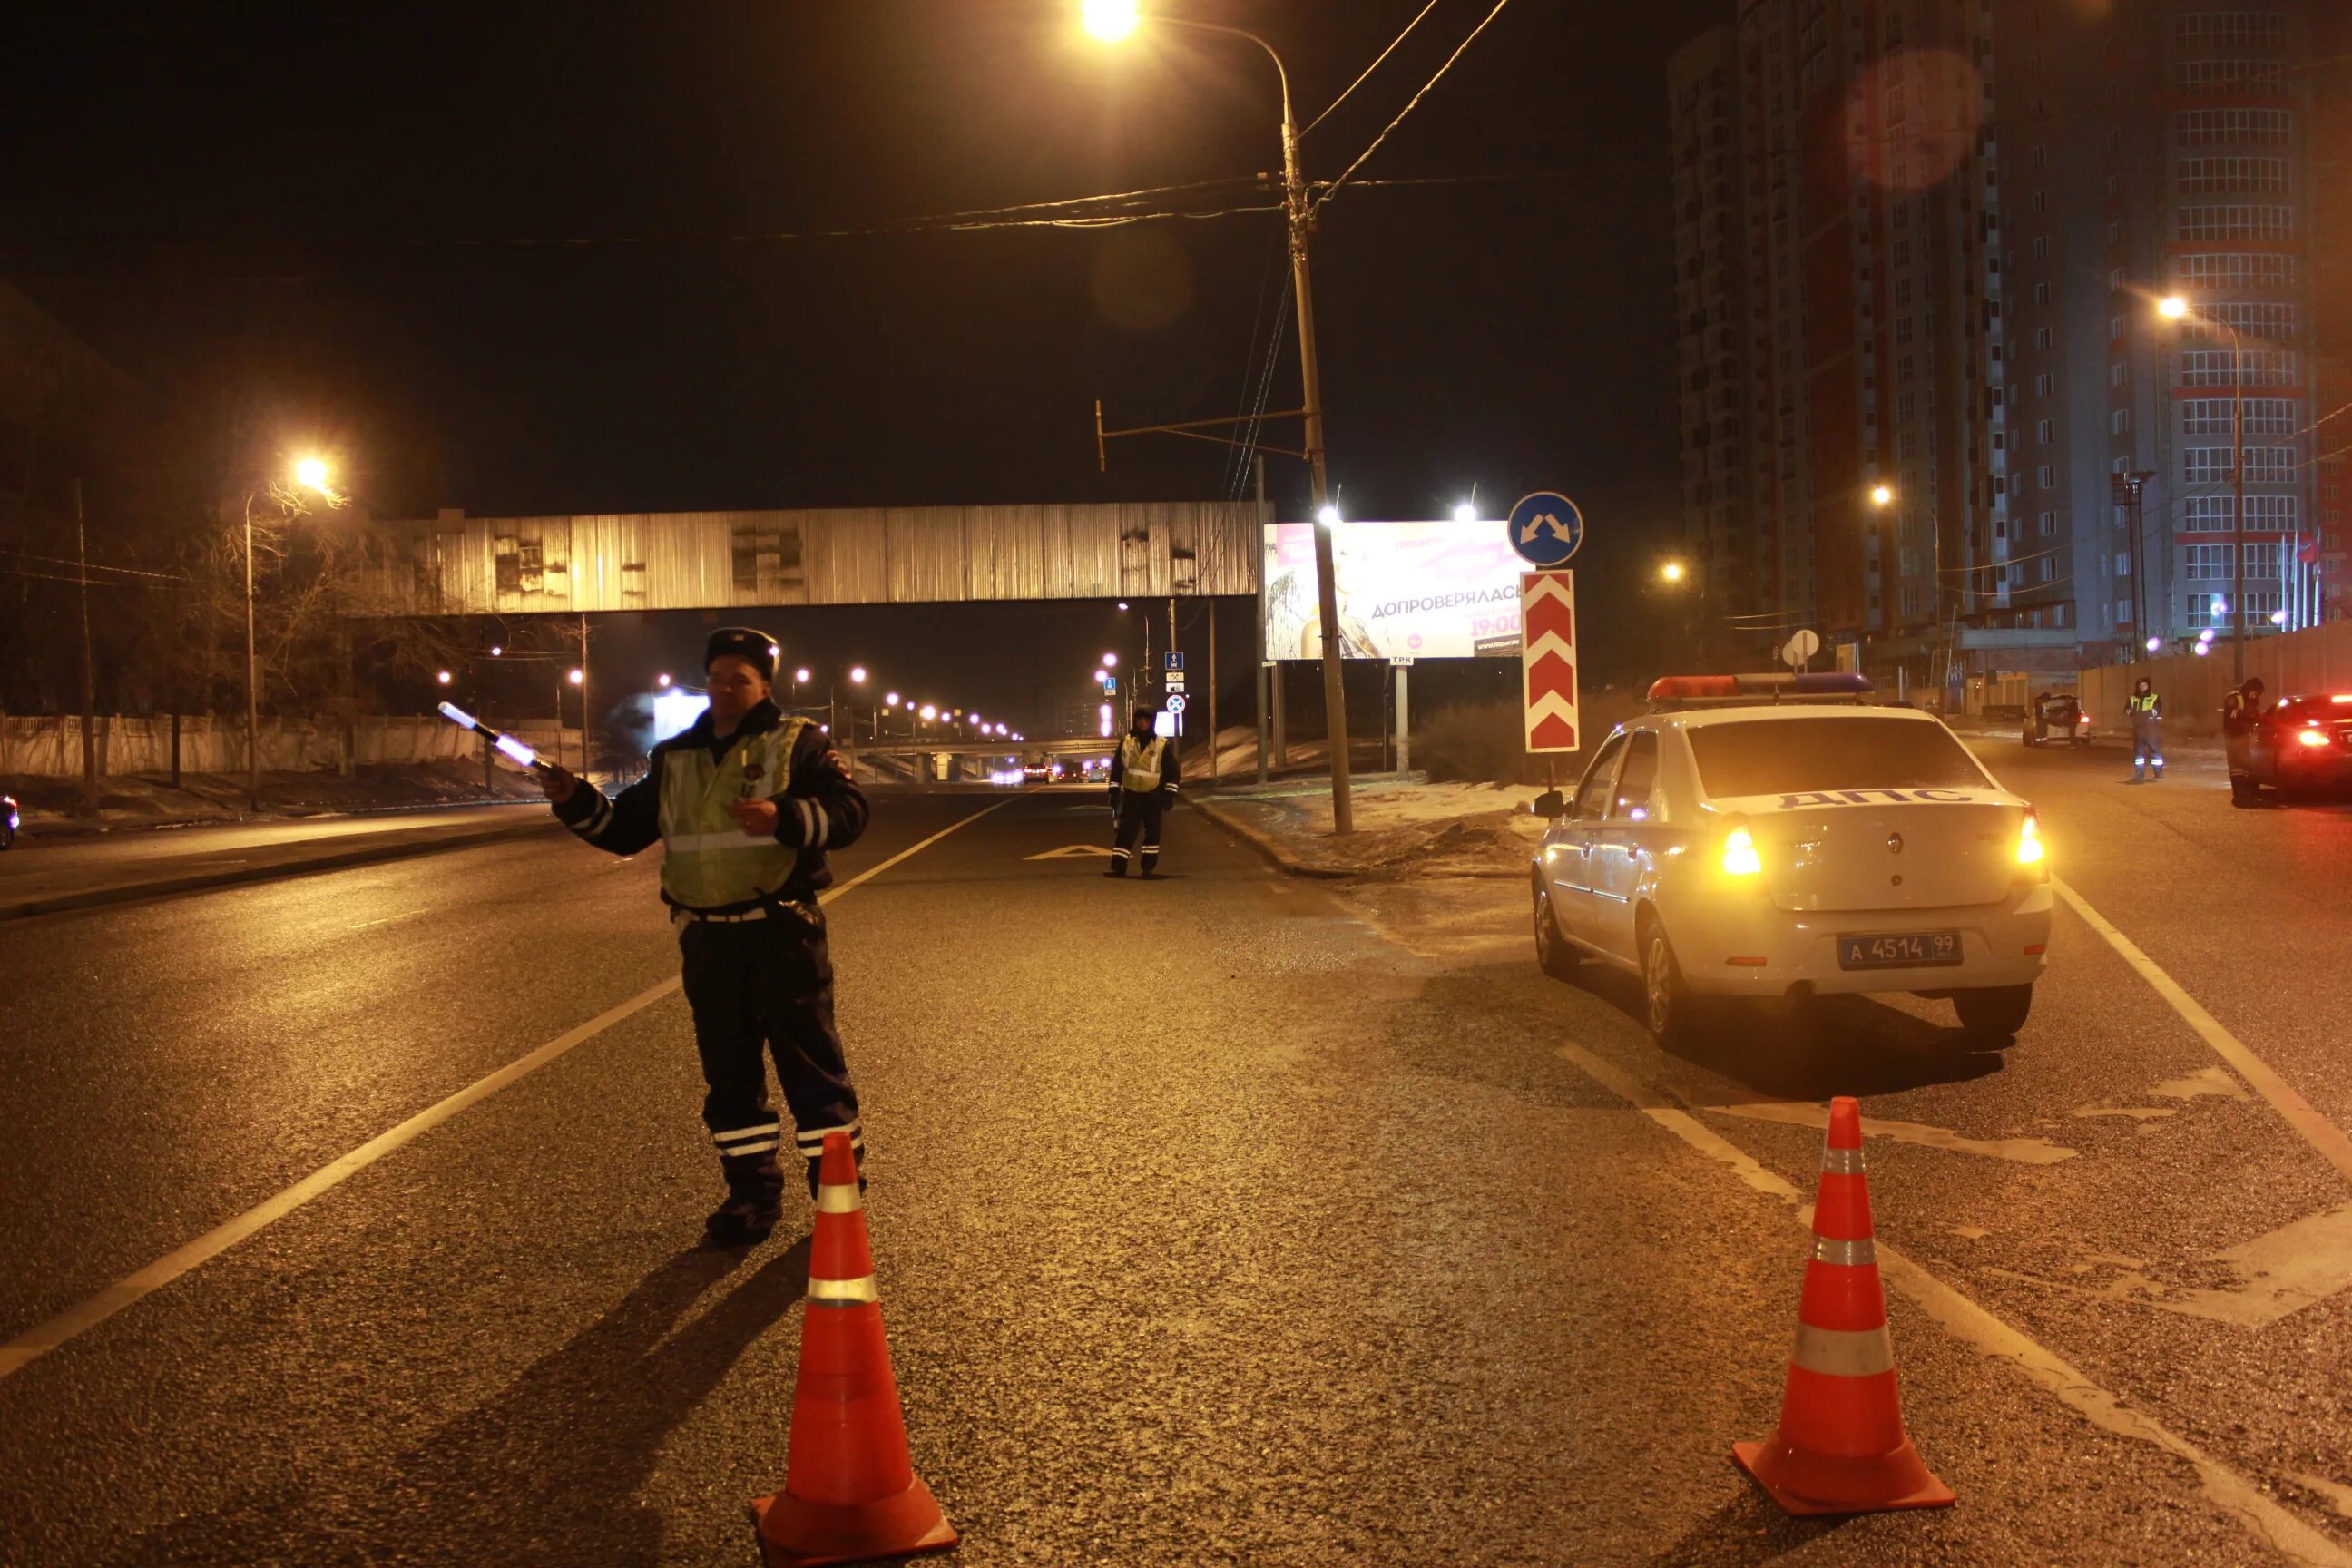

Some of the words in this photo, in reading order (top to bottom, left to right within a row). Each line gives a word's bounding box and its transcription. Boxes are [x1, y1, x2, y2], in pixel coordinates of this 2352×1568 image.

[1470, 613, 1521, 637] 19:00
[1778, 789, 1973, 808] ДПС
[1851, 945, 1863, 961] А
[1871, 937, 1923, 959] 4514
[1934, 936, 1954, 951] 99
